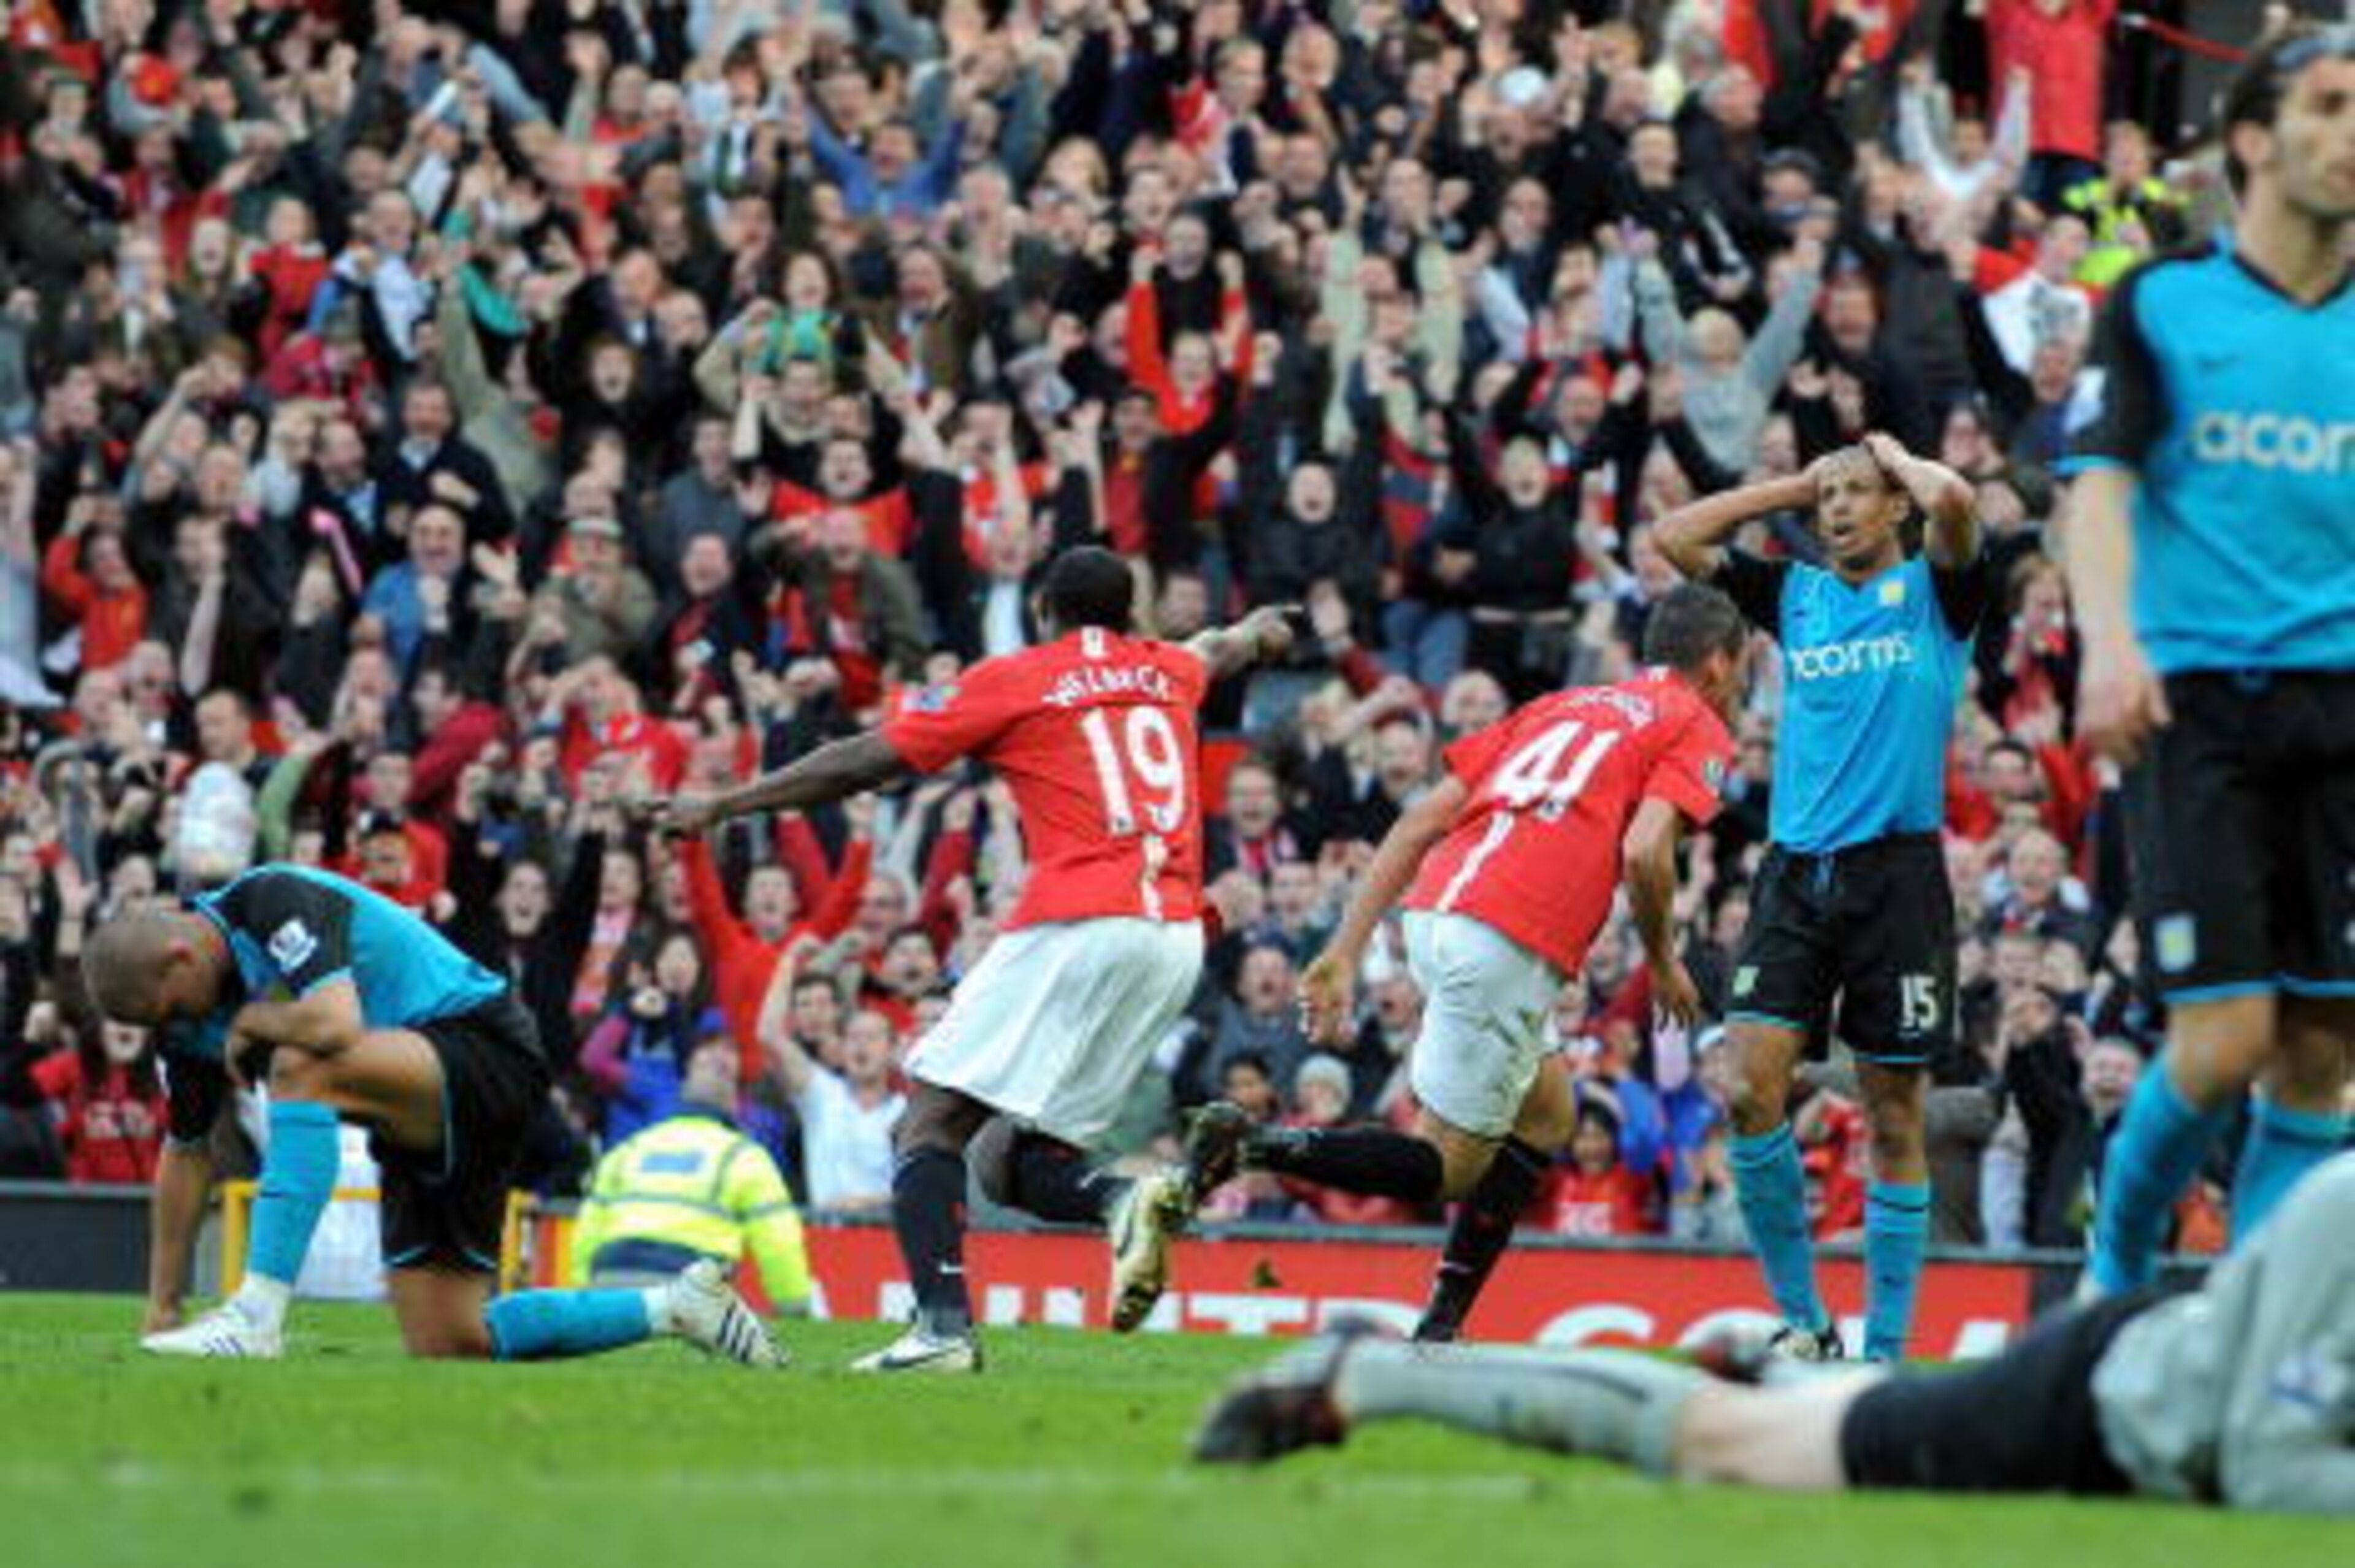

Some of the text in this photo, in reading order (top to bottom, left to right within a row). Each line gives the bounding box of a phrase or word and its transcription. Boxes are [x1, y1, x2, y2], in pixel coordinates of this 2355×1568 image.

[1082, 705, 1185, 833] 19
[1493, 720, 1622, 822] 41
[1901, 975, 1939, 1030] 15
